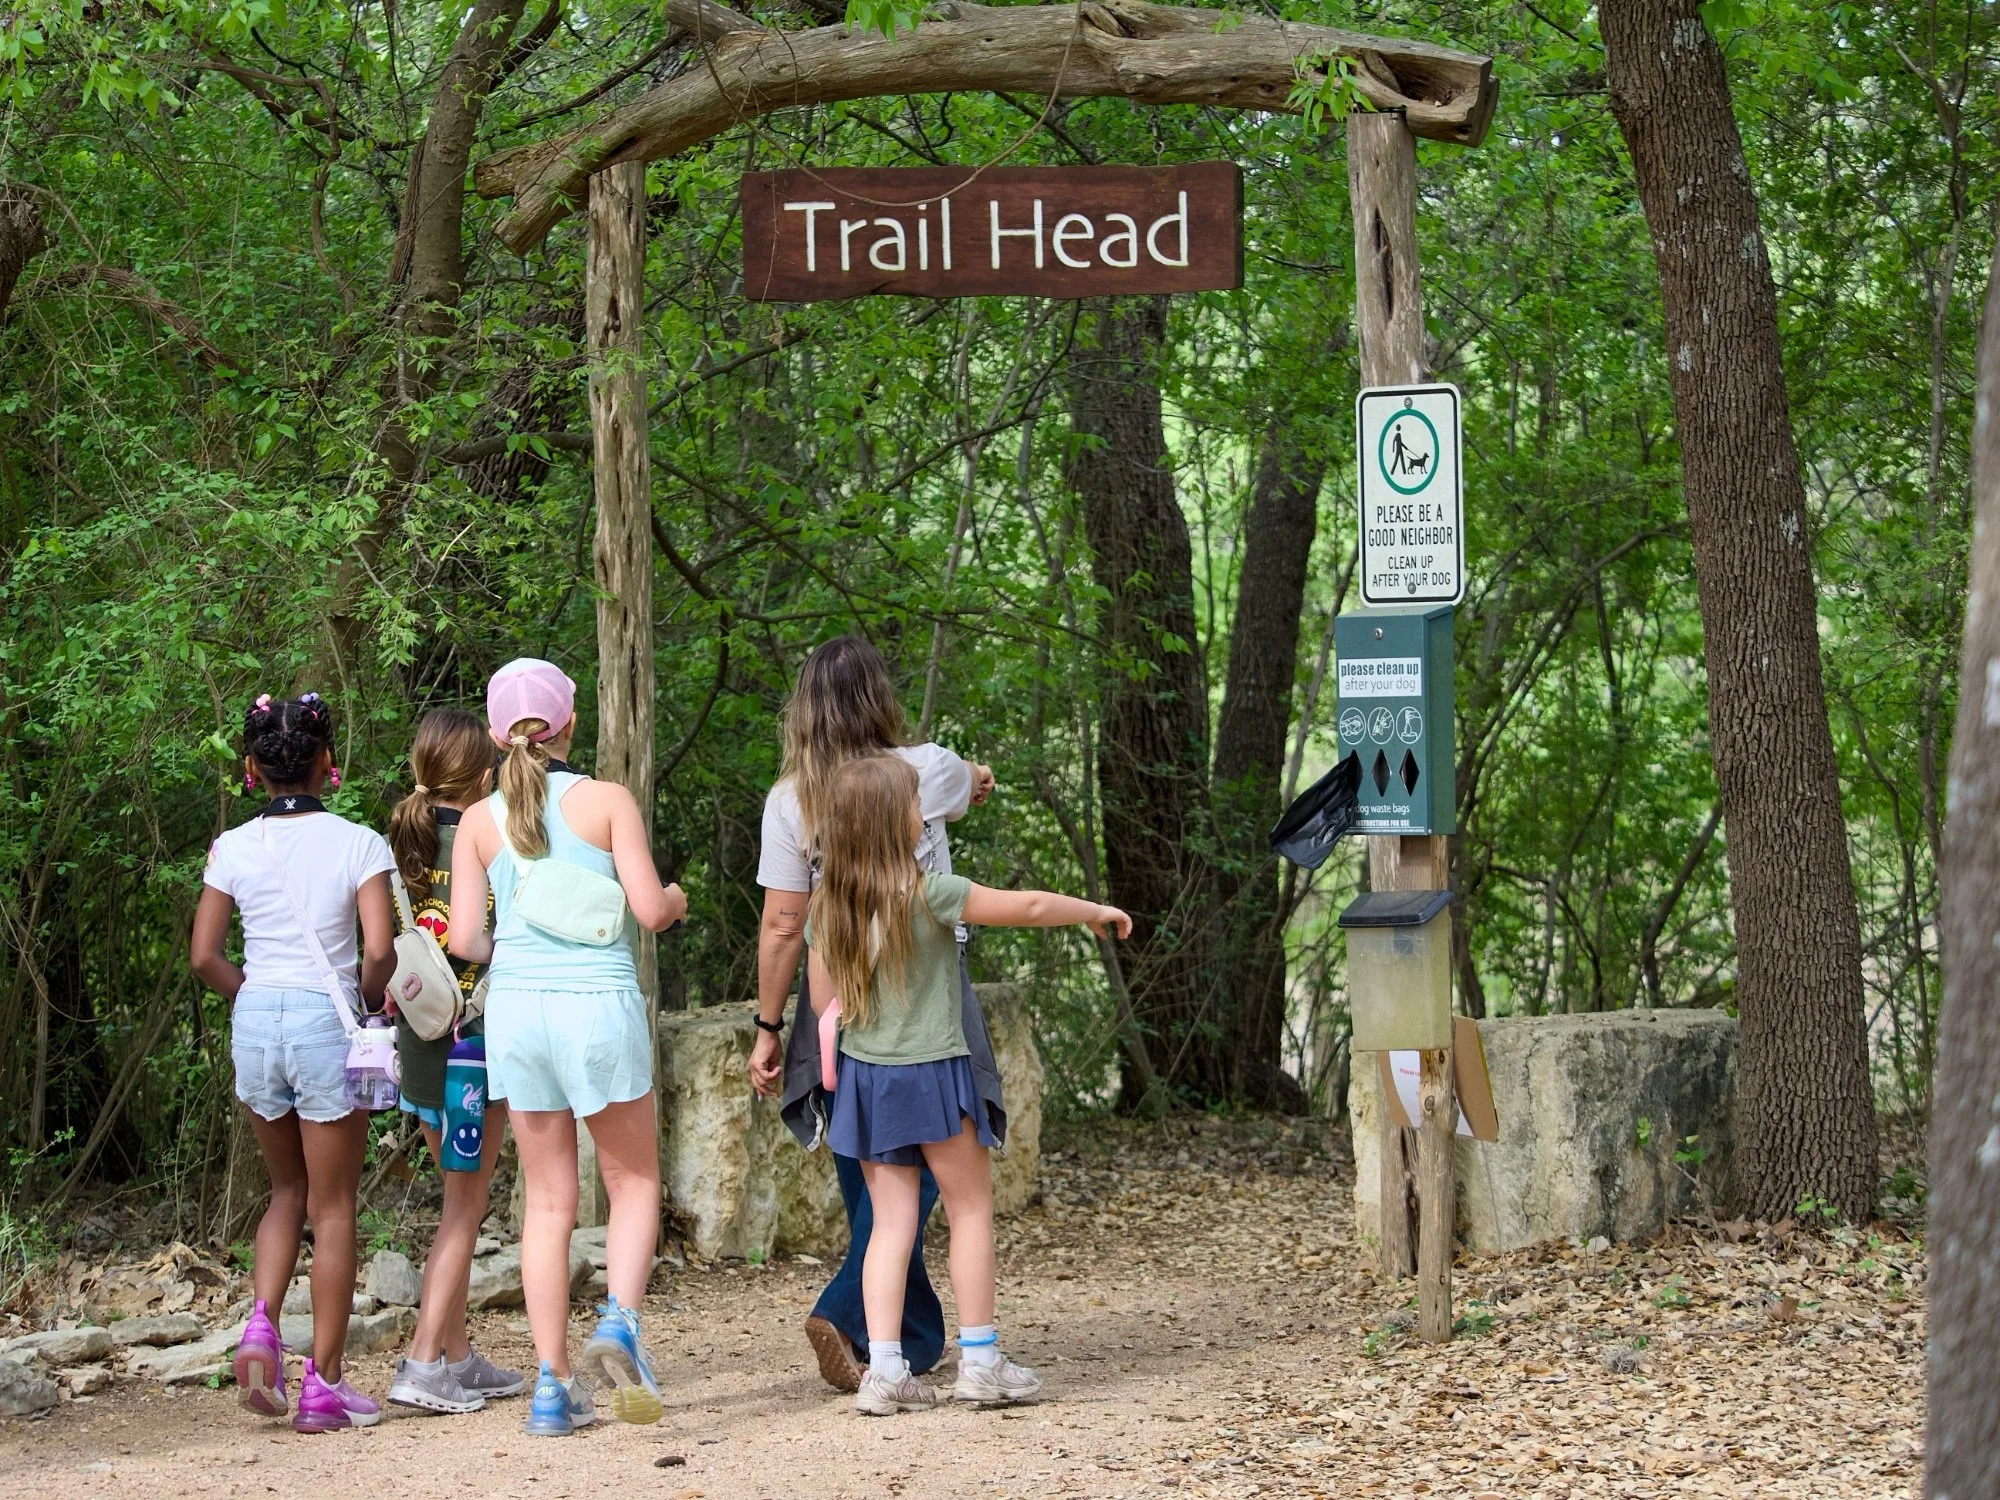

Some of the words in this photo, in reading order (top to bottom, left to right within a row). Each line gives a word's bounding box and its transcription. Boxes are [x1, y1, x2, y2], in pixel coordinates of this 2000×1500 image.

[783, 197, 952, 272] Trail
[989, 190, 1189, 271] Head
[1377, 504, 1414, 523] PLEASE
[1419, 504, 1431, 522] BE
[1436, 503, 1443, 521] A
[1368, 528, 1395, 547] GOOD
[1401, 526, 1453, 546] NEIGHBOR
[1388, 555, 1417, 570] CLEAN
[1421, 555, 1434, 569] UP
[1372, 573, 1400, 587] AFTER
[1403, 572, 1428, 586] YOUR
[1432, 572, 1451, 585] DOG
[1341, 662, 1374, 677] please
[1377, 661, 1404, 675] clean
[1407, 663, 1419, 676] up
[1345, 677, 1368, 691] after
[1370, 679, 1394, 693] your
[1396, 676, 1416, 693] dog
[1370, 804, 1391, 813] waste
[1392, 802, 1410, 816] bags
[424, 897, 450, 914] SCHOO
